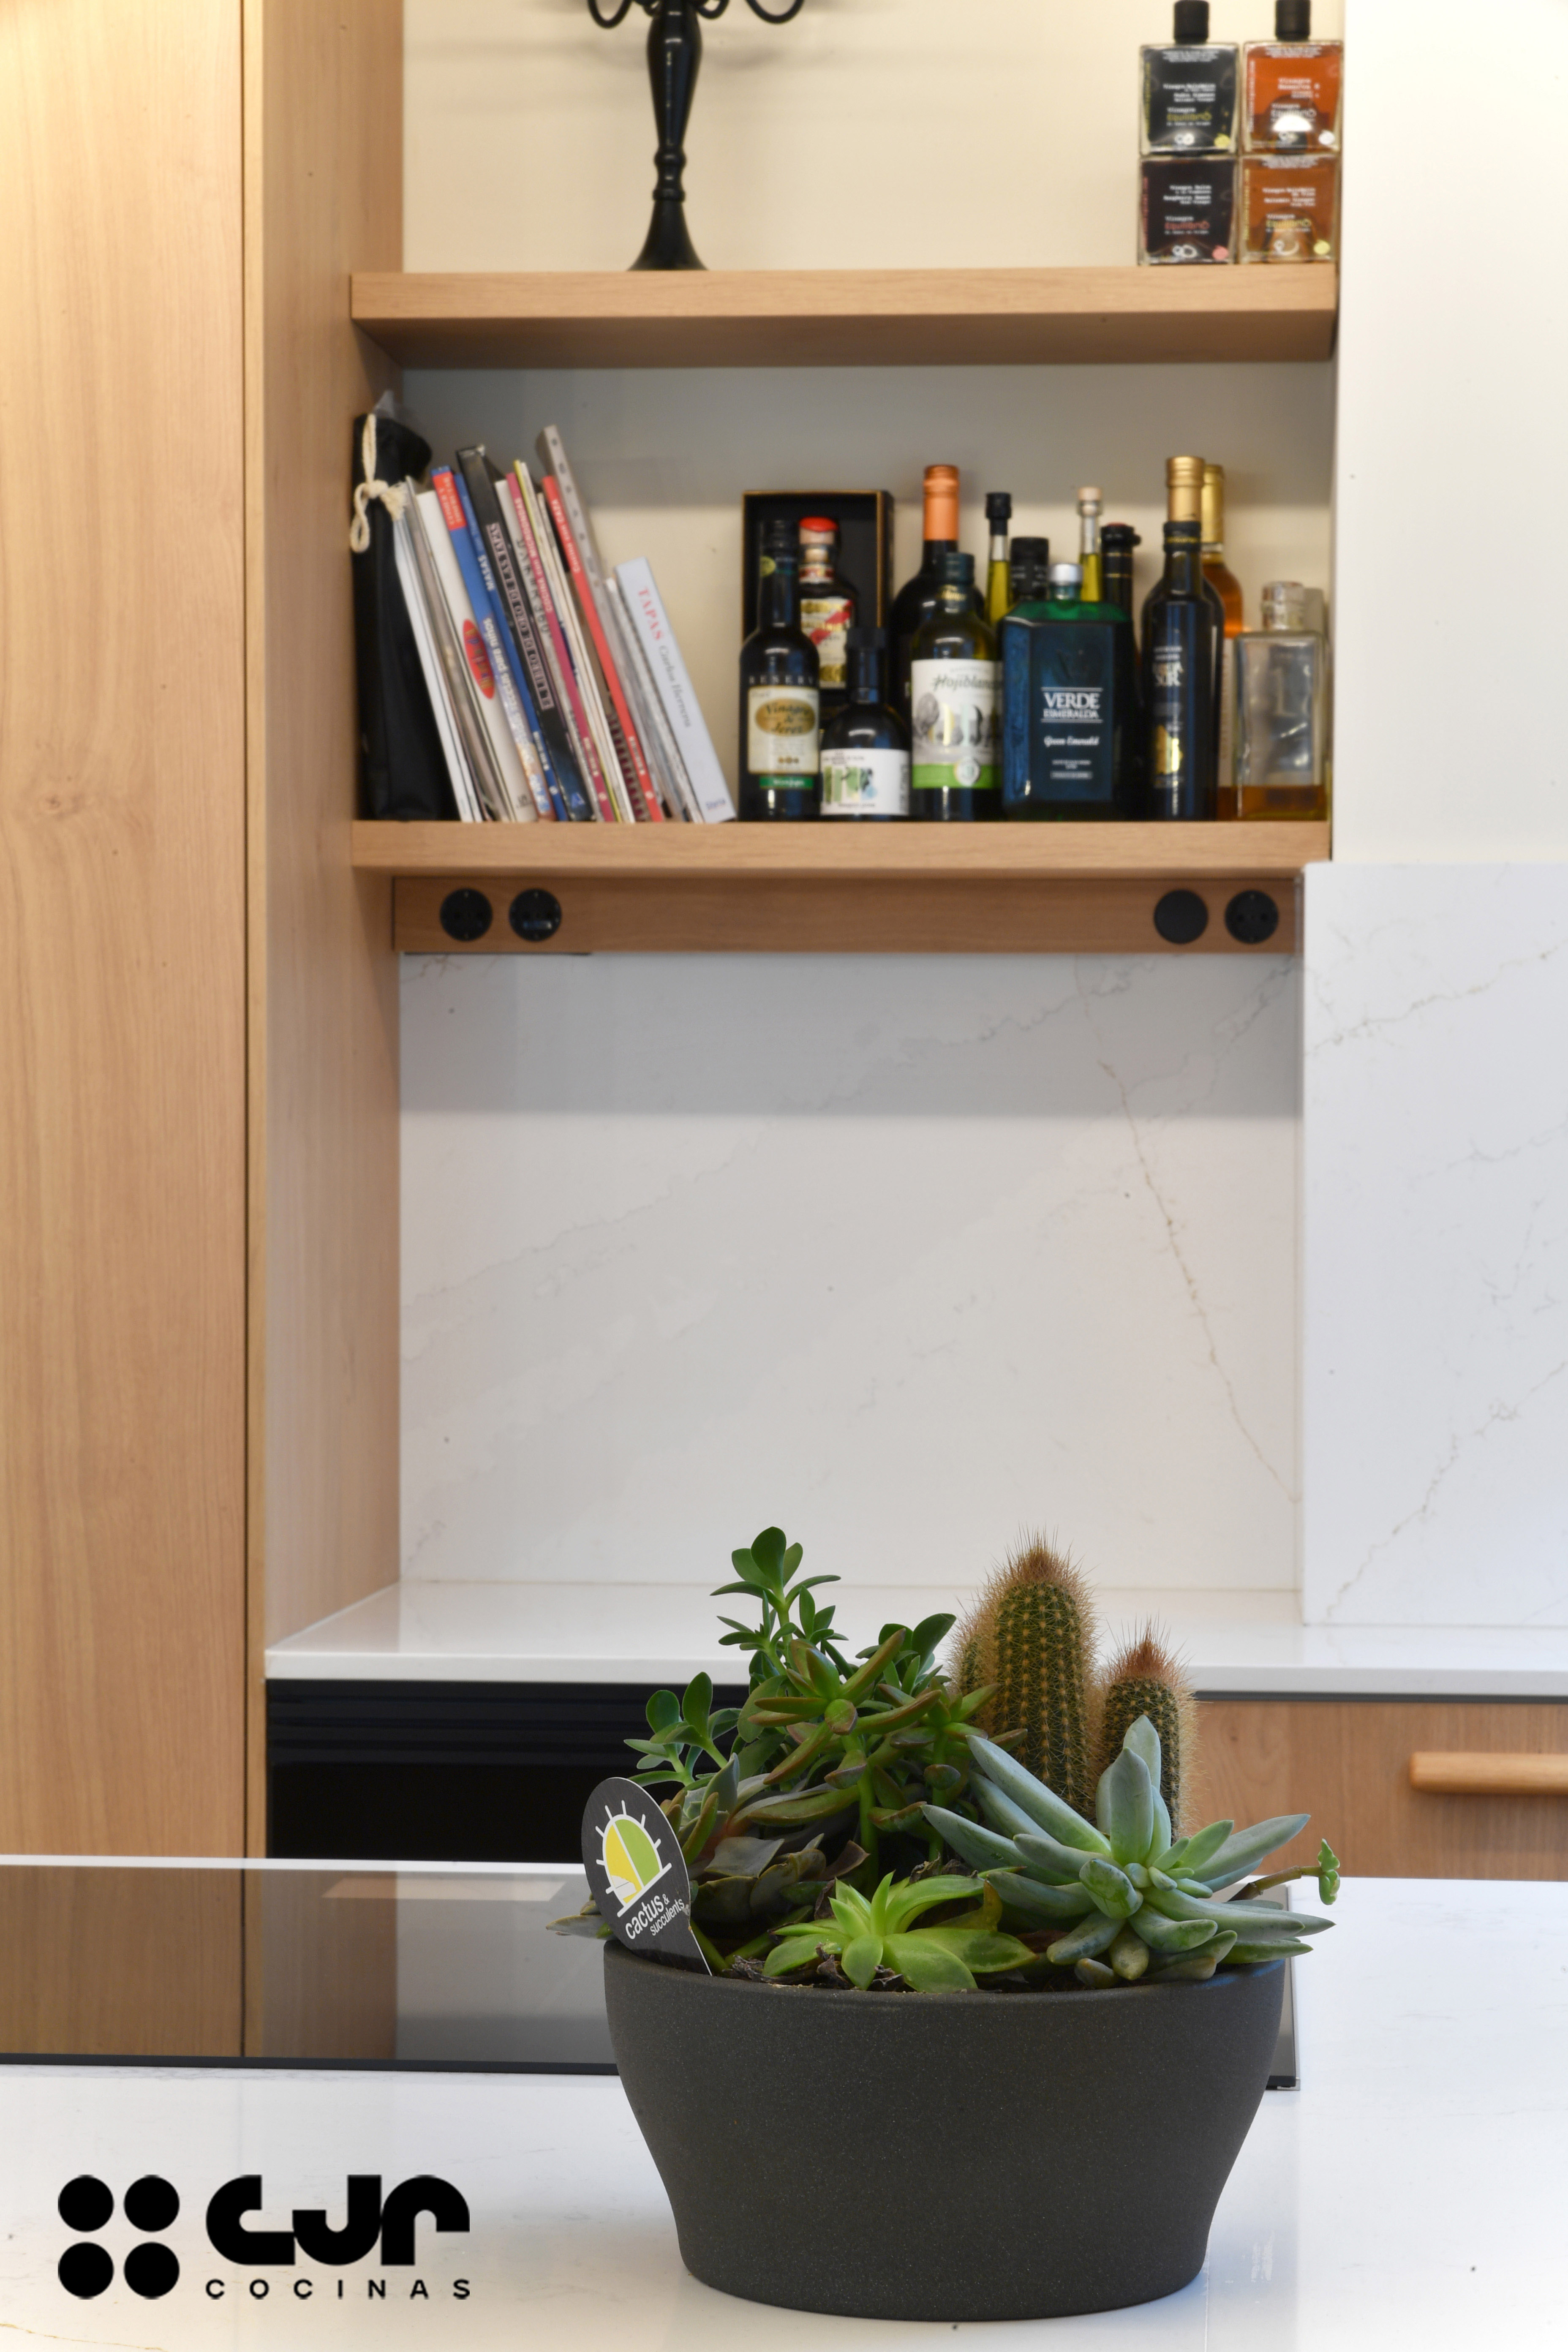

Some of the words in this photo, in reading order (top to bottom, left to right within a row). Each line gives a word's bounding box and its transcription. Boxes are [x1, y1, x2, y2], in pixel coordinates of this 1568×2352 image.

[477, 554, 495, 591] MASAS
[638, 586, 664, 640] TAPAS
[482, 617, 500, 648] niños
[492, 647, 509, 673] para
[749, 675, 814, 685] RESERV
[1043, 692, 1101, 709] VERDE
[1043, 709, 1099, 719] ESMERALDA
[625, 1895, 664, 1939] cactus
[662, 1894, 670, 1905] &
[650, 1899, 684, 1936] succulents
